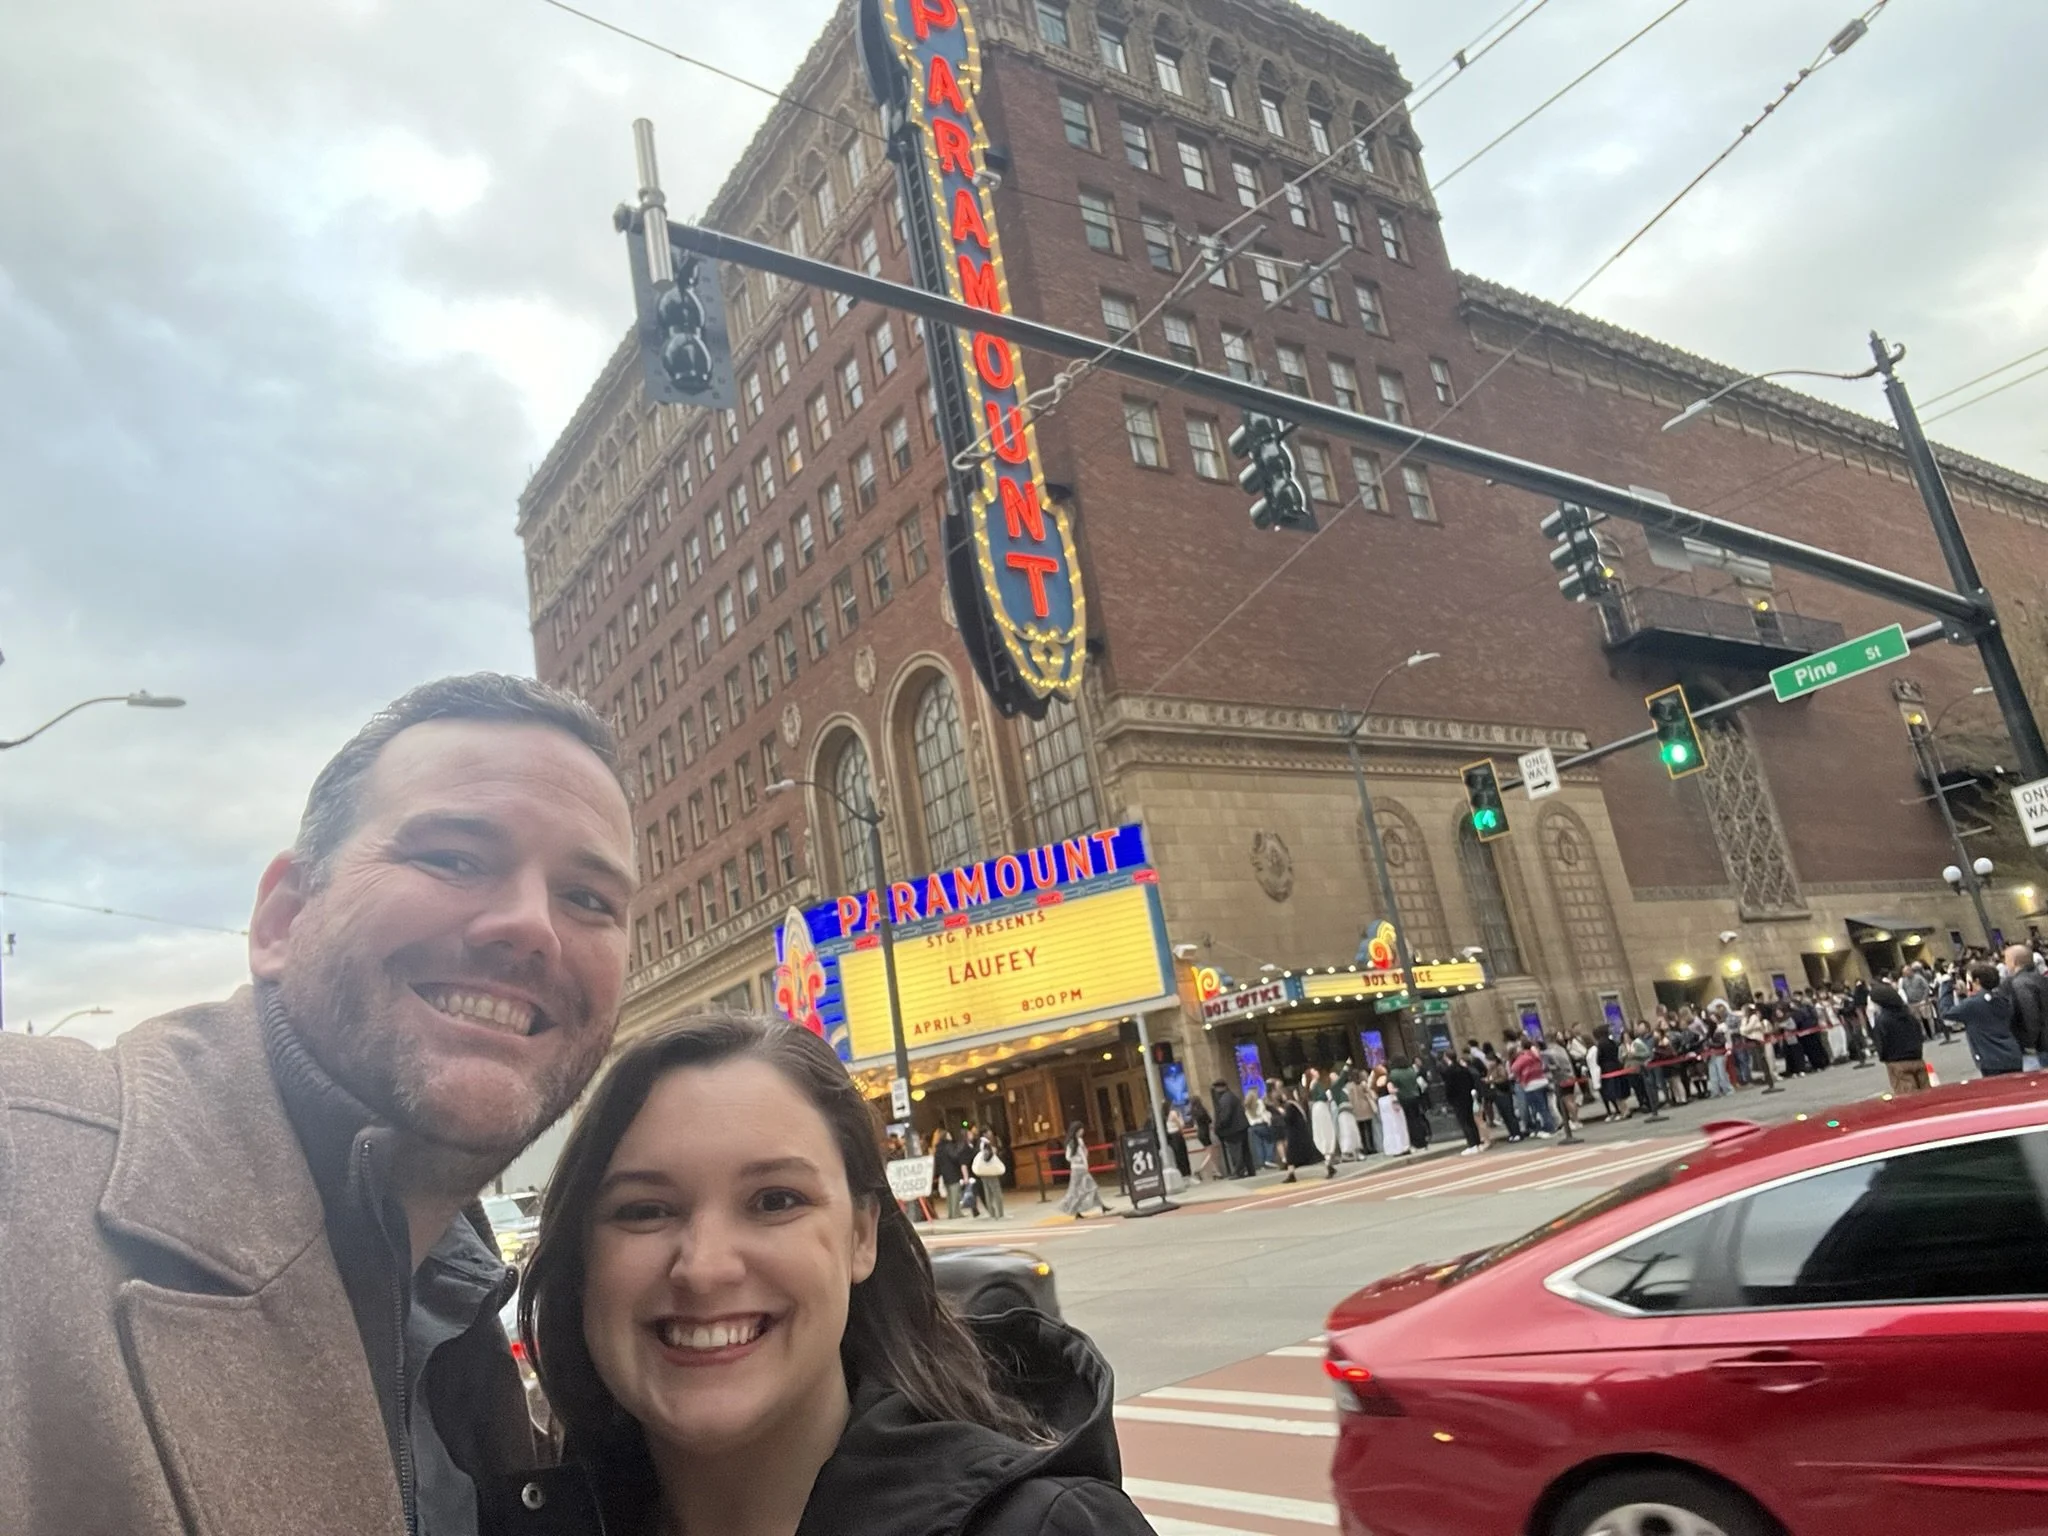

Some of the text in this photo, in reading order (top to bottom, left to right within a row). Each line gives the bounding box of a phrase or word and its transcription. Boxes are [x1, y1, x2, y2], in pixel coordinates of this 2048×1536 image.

[910, 0, 1059, 617] PARAMOUNT
[1794, 645, 1882, 687] Pine St
[1525, 753, 1546, 769] ONE
[1527, 764, 1548, 780] WAY
[2025, 803, 2048, 818] WA
[837, 828, 1119, 936] PARAMOUNT
[927, 910, 1046, 949] STG PRESENTS
[948, 946, 1038, 985] LAUFEY
[1362, 974, 1387, 987] BOX
[1204, 984, 1283, 1018] BOX OFFICE
[914, 1012, 973, 1036] APRIL 9
